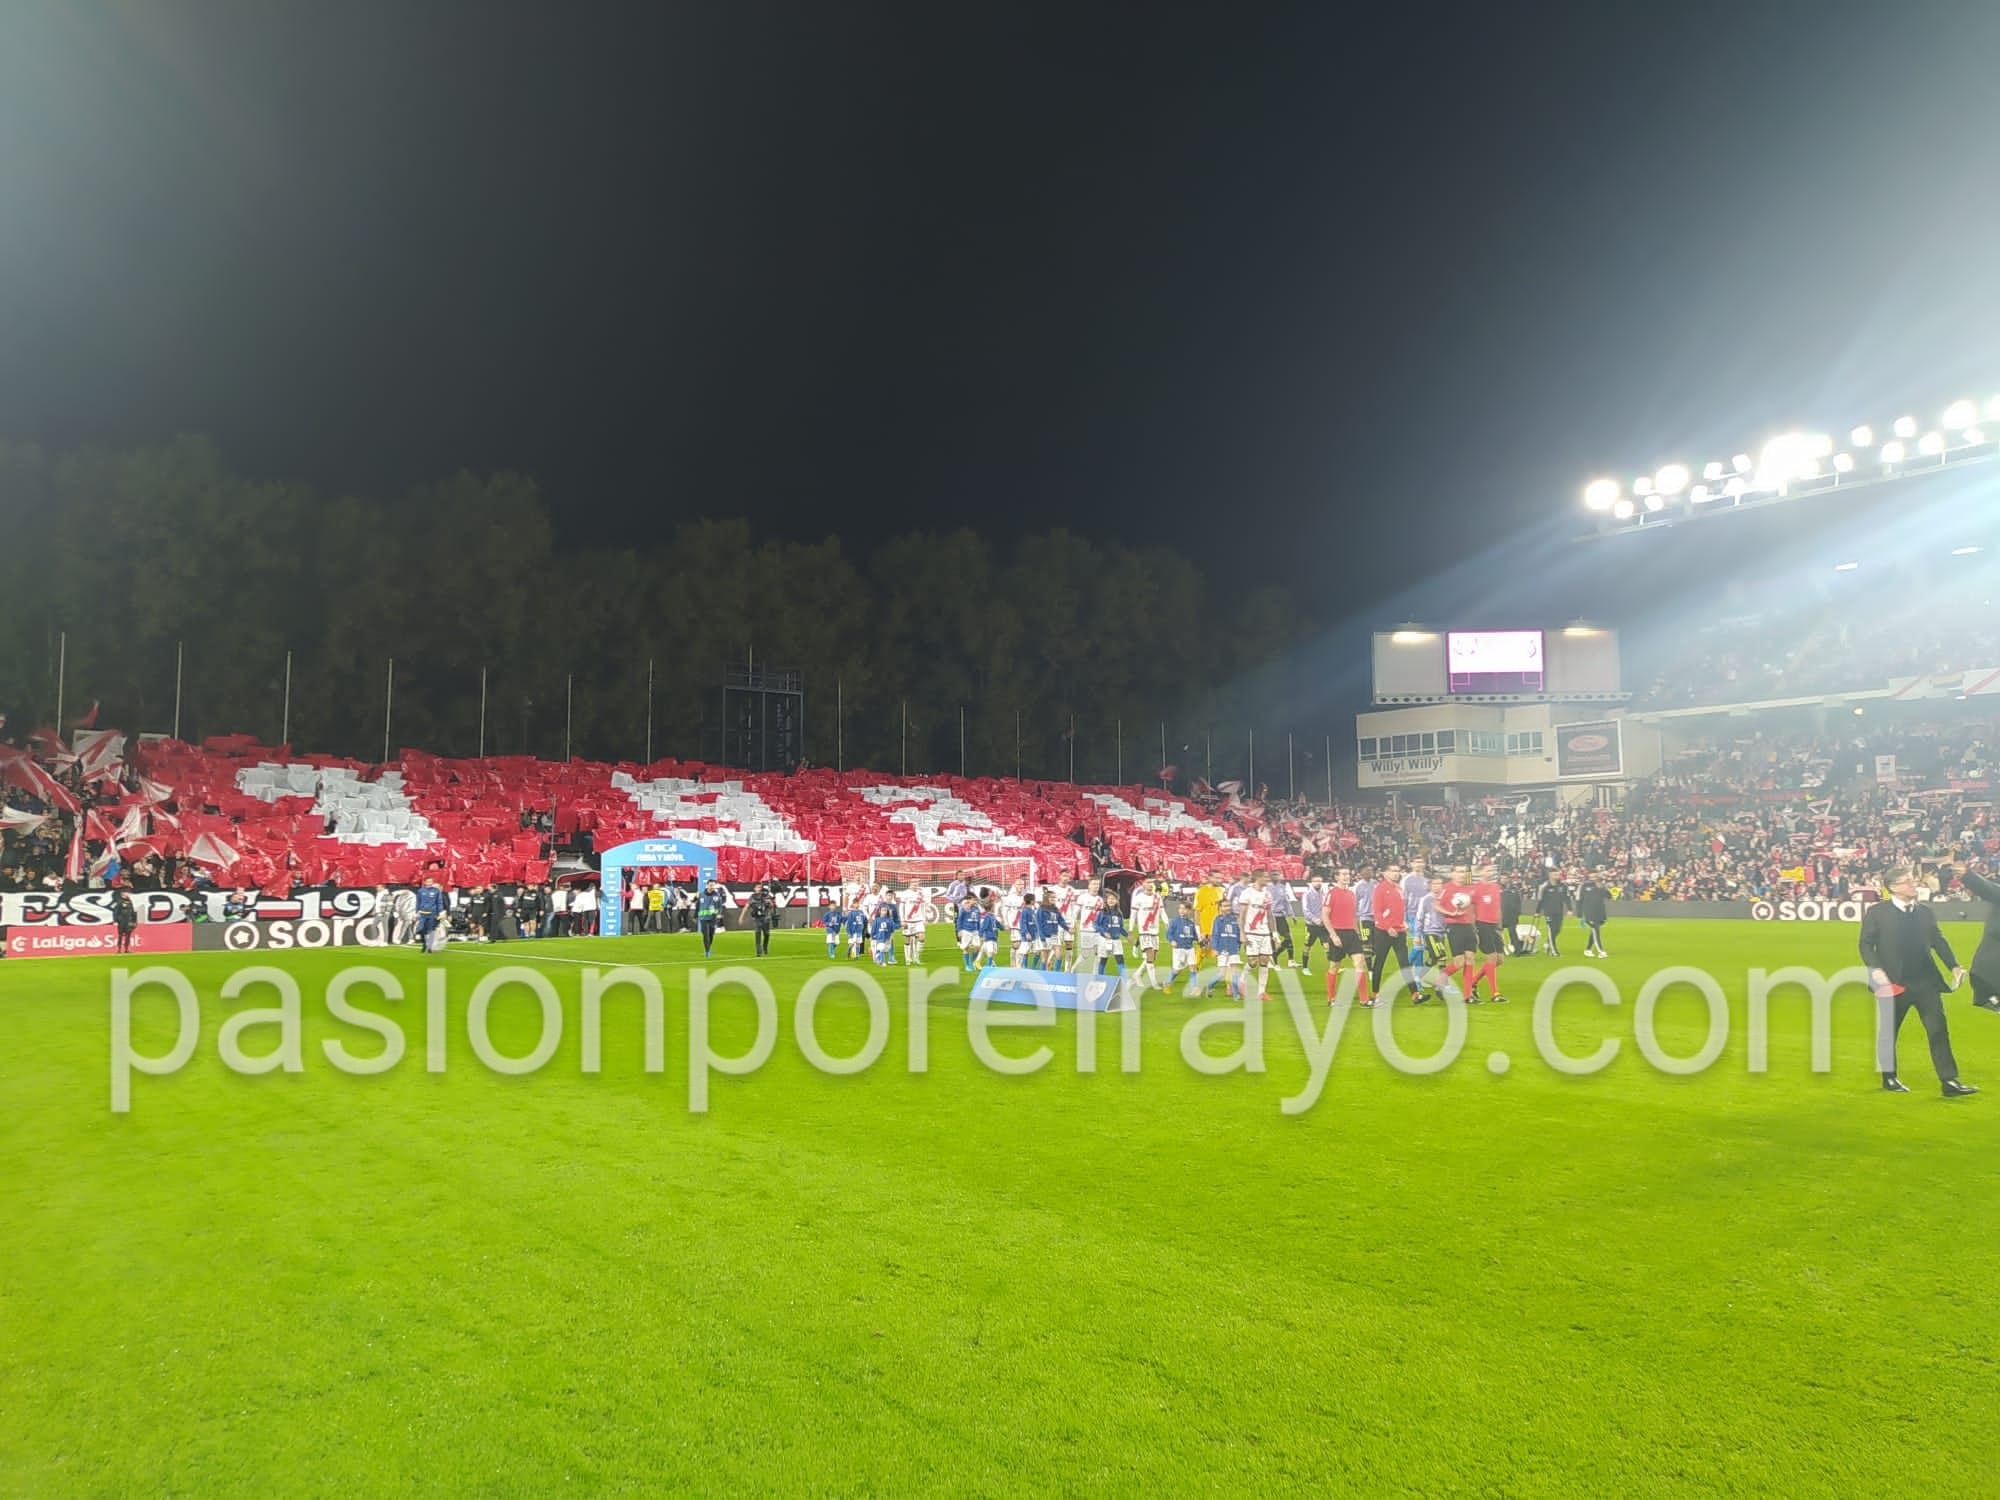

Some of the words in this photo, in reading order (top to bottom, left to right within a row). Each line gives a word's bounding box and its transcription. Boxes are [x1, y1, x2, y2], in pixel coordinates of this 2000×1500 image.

[1371, 758, 1405, 774] Willy!
[1408, 756, 1443, 771] Willy!
[33, 935, 85, 950] LaLiga
[267, 918, 388, 949] sora
